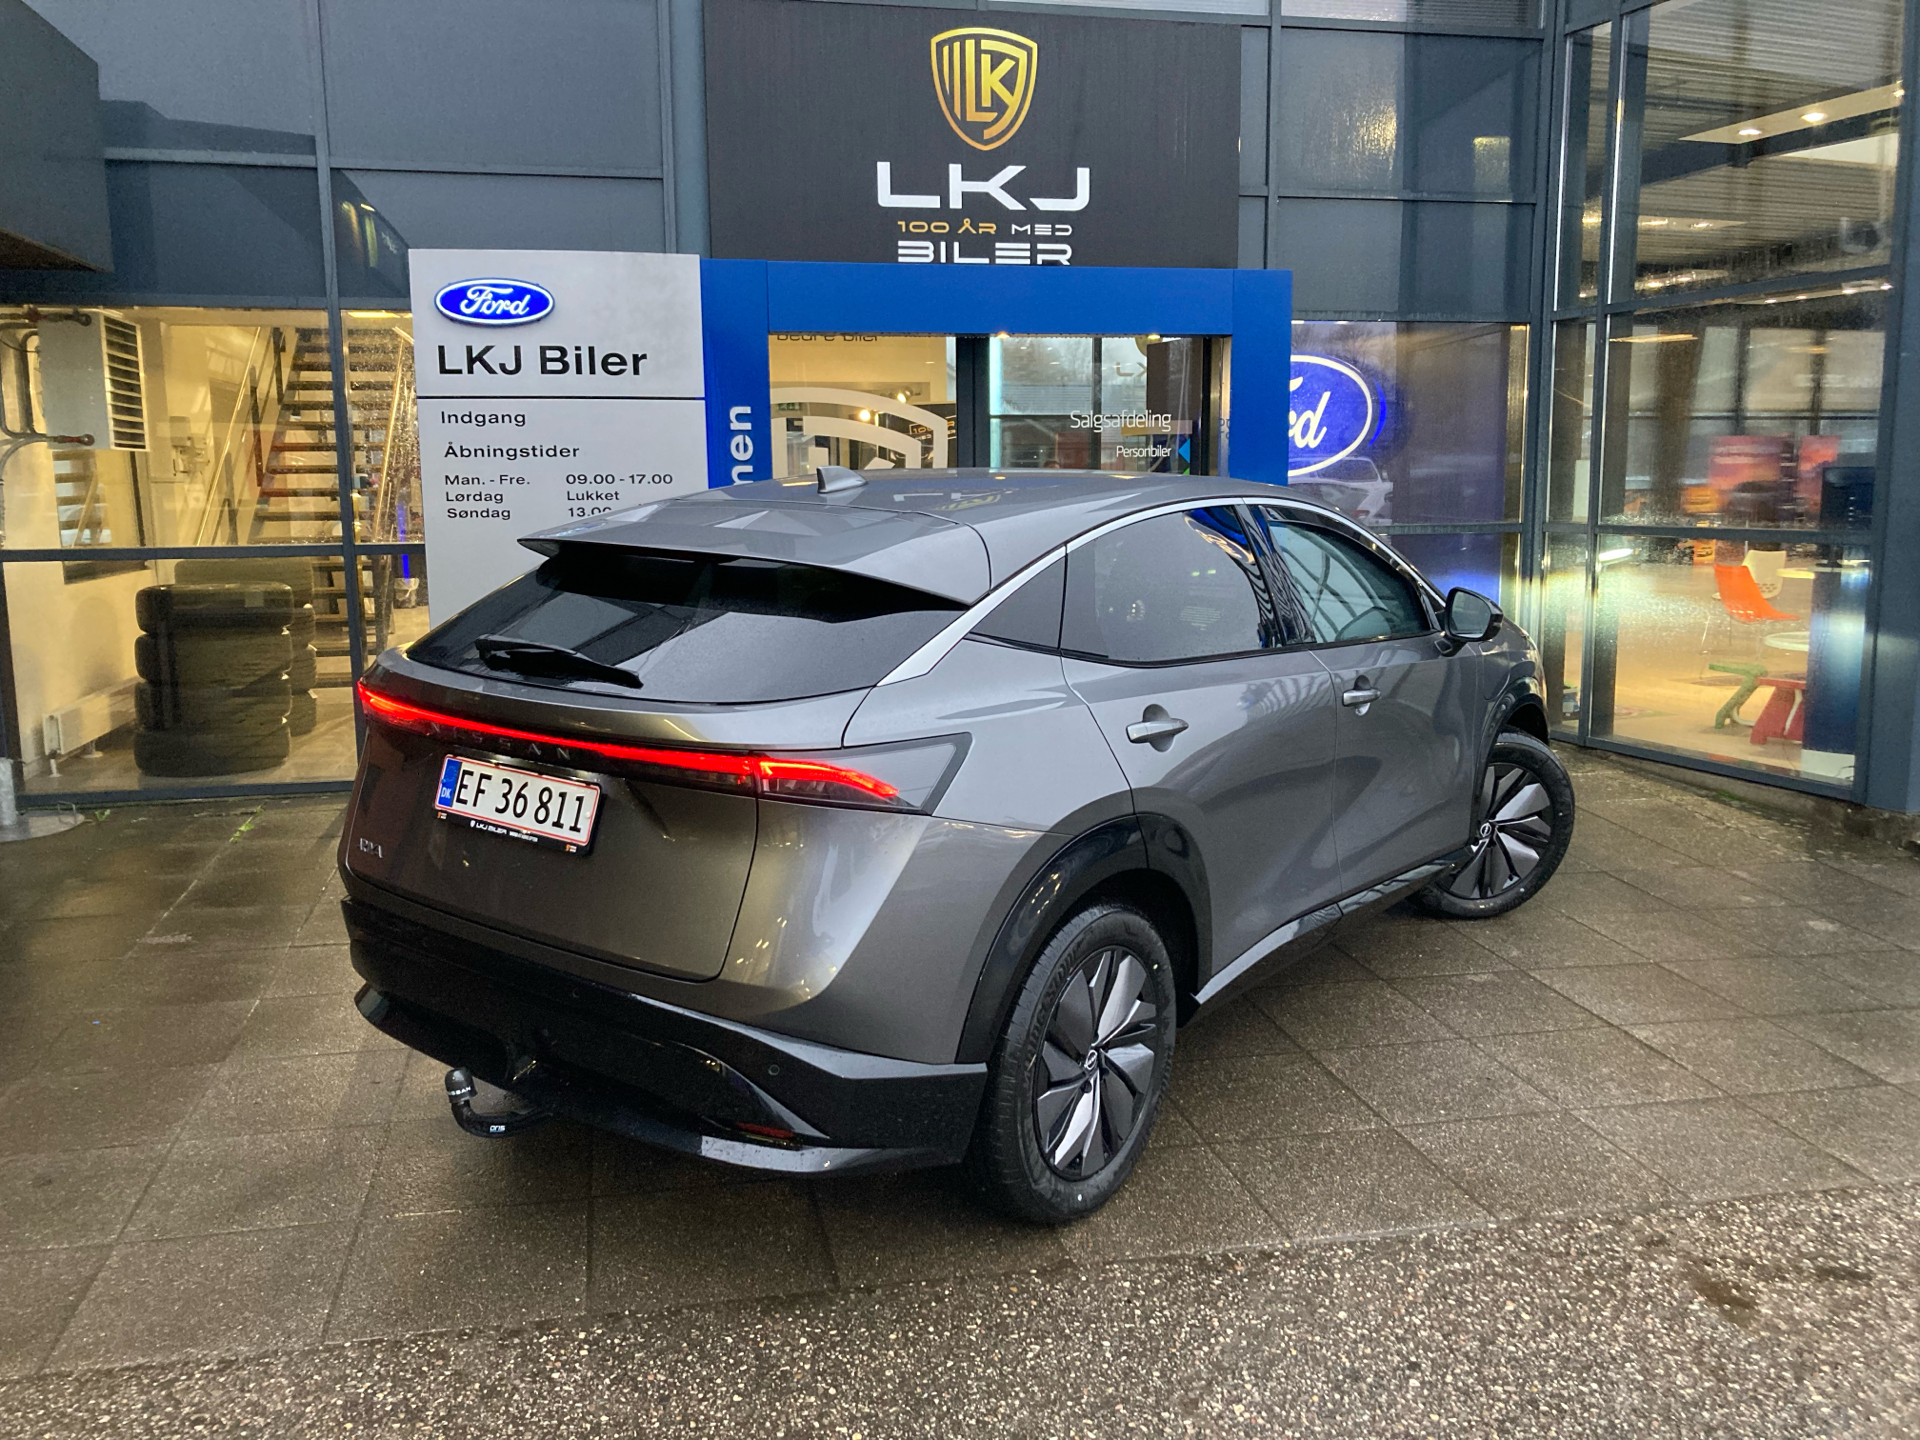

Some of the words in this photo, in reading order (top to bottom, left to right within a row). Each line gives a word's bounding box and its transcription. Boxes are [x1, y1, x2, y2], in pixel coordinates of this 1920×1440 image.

[876, 161, 1090, 212] LKJ
[897, 220, 950, 234] 100
[957, 218, 997, 235] ÅR
[1011, 223, 1073, 236] MED
[897, 240, 1073, 266] BILER
[459, 284, 530, 316] Ford
[437, 345, 523, 376] LKJ
[539, 345, 648, 376] Biler
[440, 410, 527, 427] Indgang
[1070, 410, 1172, 432] Salgsafdeling
[444, 441, 580, 460] Åbningstider
[1116, 445, 1172, 458] Personbiler
[445, 475, 486, 486] Man.
[499, 475, 531, 485] Fre.
[566, 473, 616, 485] 09.00
[628, 473, 673, 485] 17.00
[445, 491, 504, 505] Lørdag
[566, 490, 620, 501] Lukket
[446, 507, 512, 520] Søndag
[440, 786, 452, 799] DK
[455, 769, 492, 807] EF
